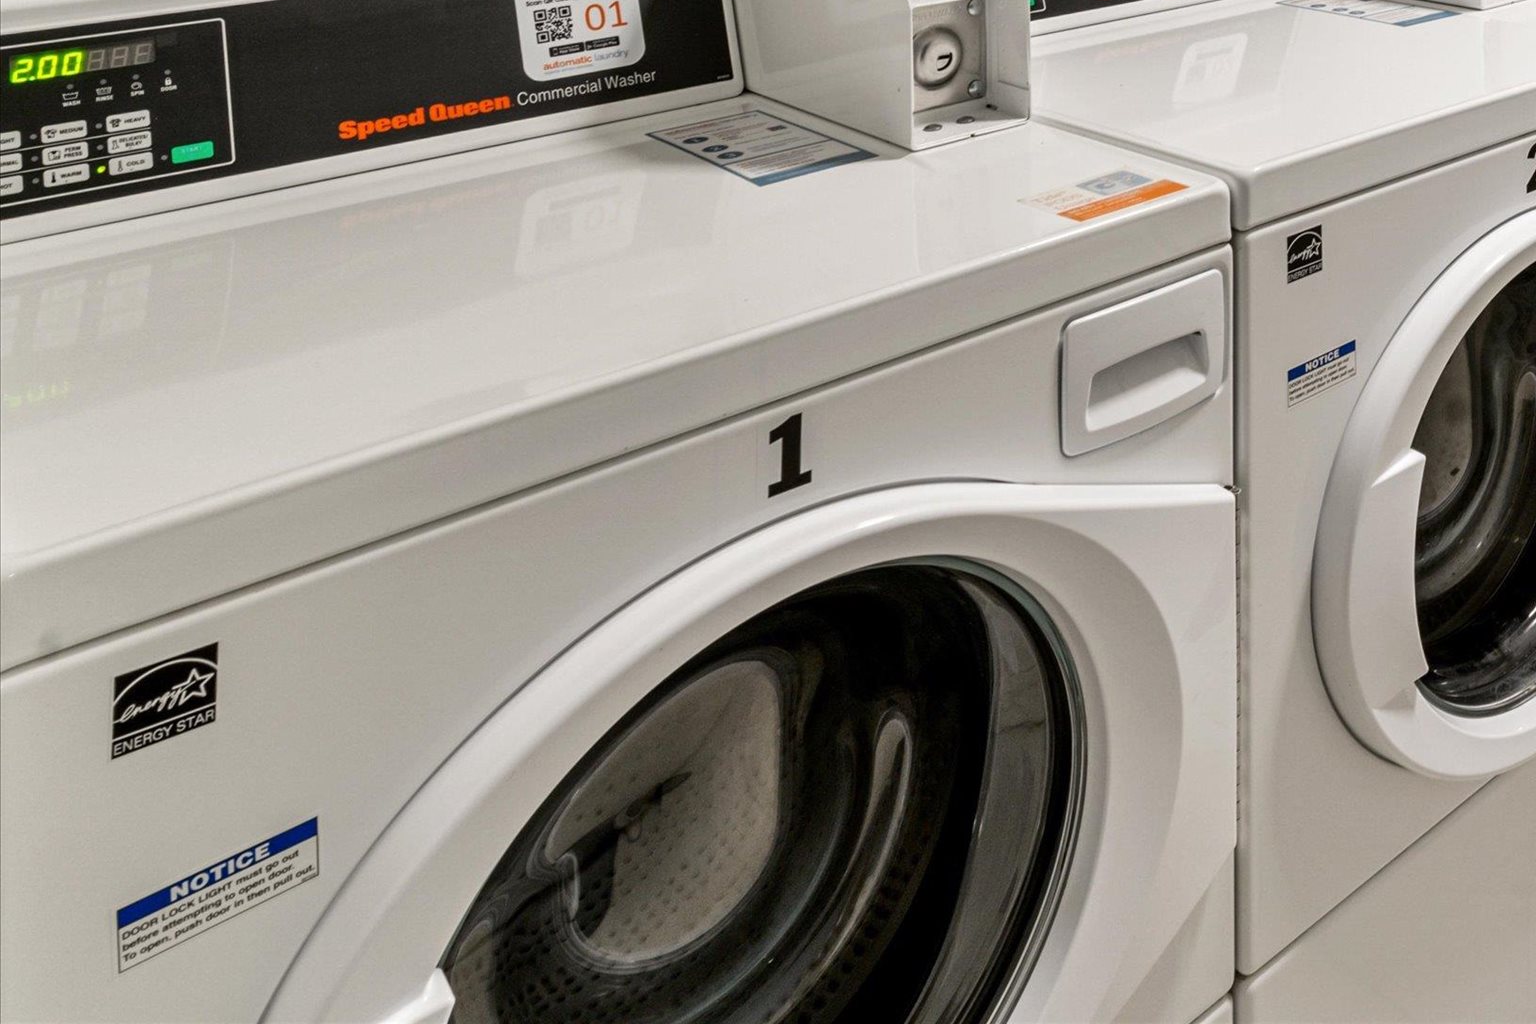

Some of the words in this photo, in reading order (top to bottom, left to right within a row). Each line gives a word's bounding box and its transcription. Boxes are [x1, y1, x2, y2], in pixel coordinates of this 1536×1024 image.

[584, 0, 628, 31] 01
[11, 51, 83, 83] 2.00
[544, 56, 592, 70] automatic
[594, 49, 629, 62] laundry
[96, 94, 113, 102] RINSE
[338, 108, 425, 140] Speed
[429, 96, 512, 122] Queen
[517, 78, 601, 106] Commercial
[604, 69, 656, 89] Washer
[124, 116, 146, 124] HEAVY
[126, 159, 145, 167] COLD
[1305, 349, 1340, 373] NOTICE
[768, 412, 812, 498] 1
[113, 724, 173, 756] ENERGY
[176, 709, 215, 733] STAR
[170, 842, 270, 902] NOTICE
[122, 917, 158, 940] DOOR
[161, 899, 195, 921] LOCK
[199, 880, 233, 904] LIGHT
[236, 867, 262, 885] must
[265, 861, 279, 872] go
[282, 850, 299, 863] out
[122, 929, 159, 952] before
[162, 900, 222, 932] attempting
[225, 893, 235, 901] to
[238, 878, 265, 894] open
[268, 863, 295, 880] door.
[123, 951, 137, 962] To
[174, 919, 202, 938] push
[205, 905, 231, 922] door
[234, 898, 244, 907] in
[247, 886, 270, 901] then
[273, 874, 293, 890] pull
[295, 864, 315, 878] out.
